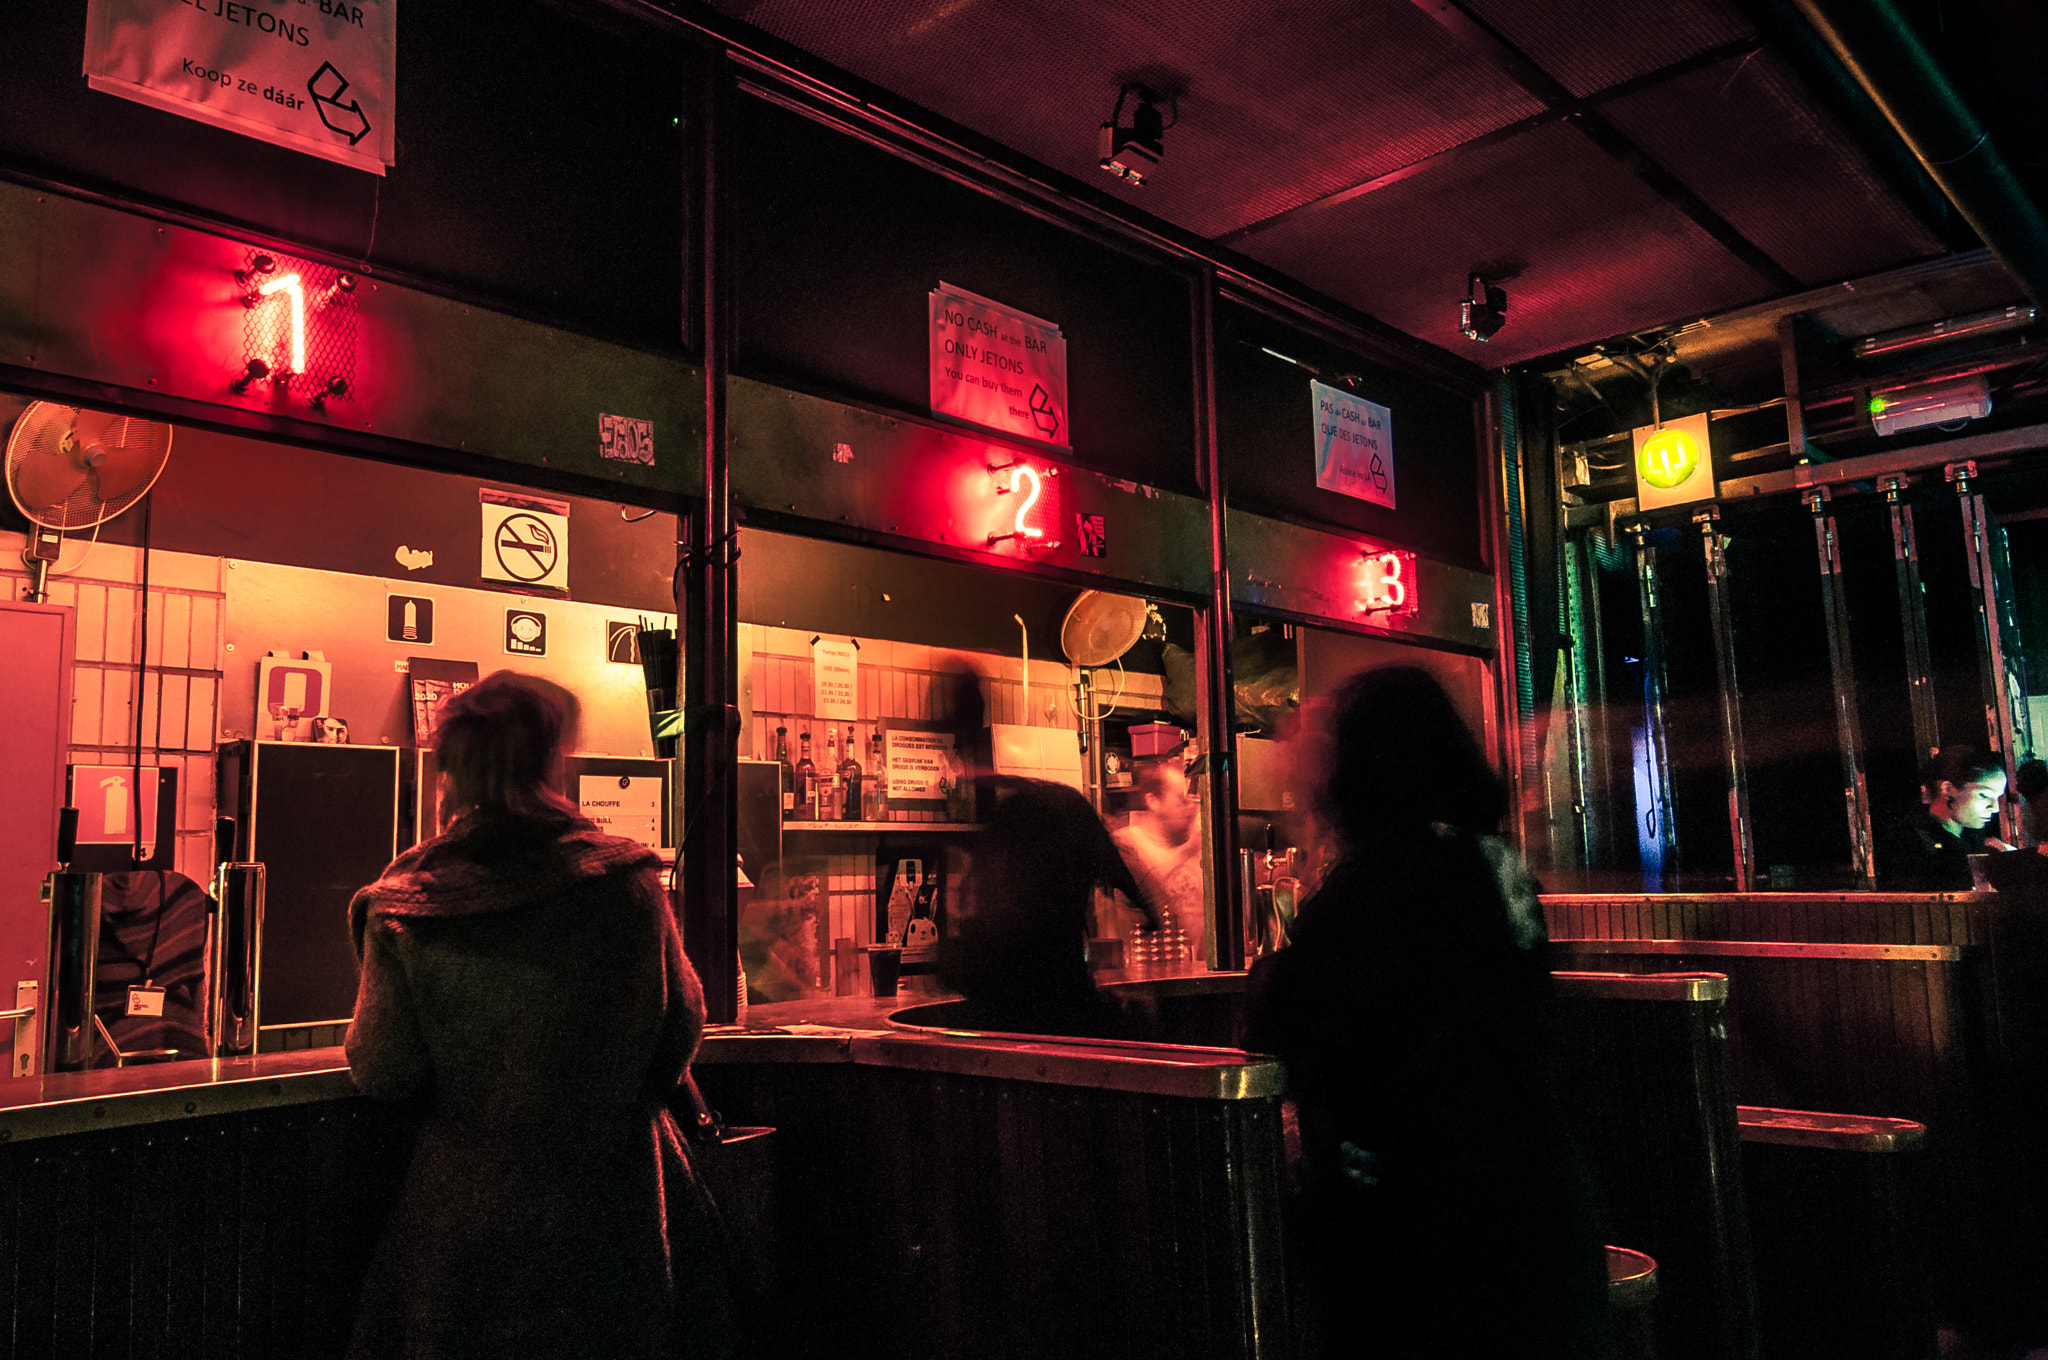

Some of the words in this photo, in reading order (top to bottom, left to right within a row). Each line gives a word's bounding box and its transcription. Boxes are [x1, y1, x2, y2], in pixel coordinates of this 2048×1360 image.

[214, 0, 309, 46] JETONS
[320, 0, 364, 29] BAR
[182, 58, 231, 88] Koop
[237, 77, 257, 95] ze
[263, 86, 305, 111] dáár
[260, 273, 305, 374] 1
[945, 309, 964, 327] NO
[967, 317, 997, 339] CASH
[1001, 334, 1008, 342] at
[1009, 336, 1022, 347] the
[1025, 336, 1047, 354] BAR
[945, 339, 978, 360] ONLY
[980, 351, 1024, 375] JETONS
[945, 366, 963, 381] You
[966, 373, 980, 386] can
[982, 377, 999, 392] buy
[1001, 383, 1022, 398] them
[1009, 406, 1029, 419] there
[1320, 400, 1333, 414] PAS
[1341, 408, 1360, 424] CASH
[1367, 416, 1381, 430] BAR
[1321, 423, 1337, 437] QUE
[1339, 428, 1351, 442] DES
[1352, 432, 1378, 450] JETONS
[1011, 466, 1042, 537] 2
[1380, 553, 1404, 605] 3
